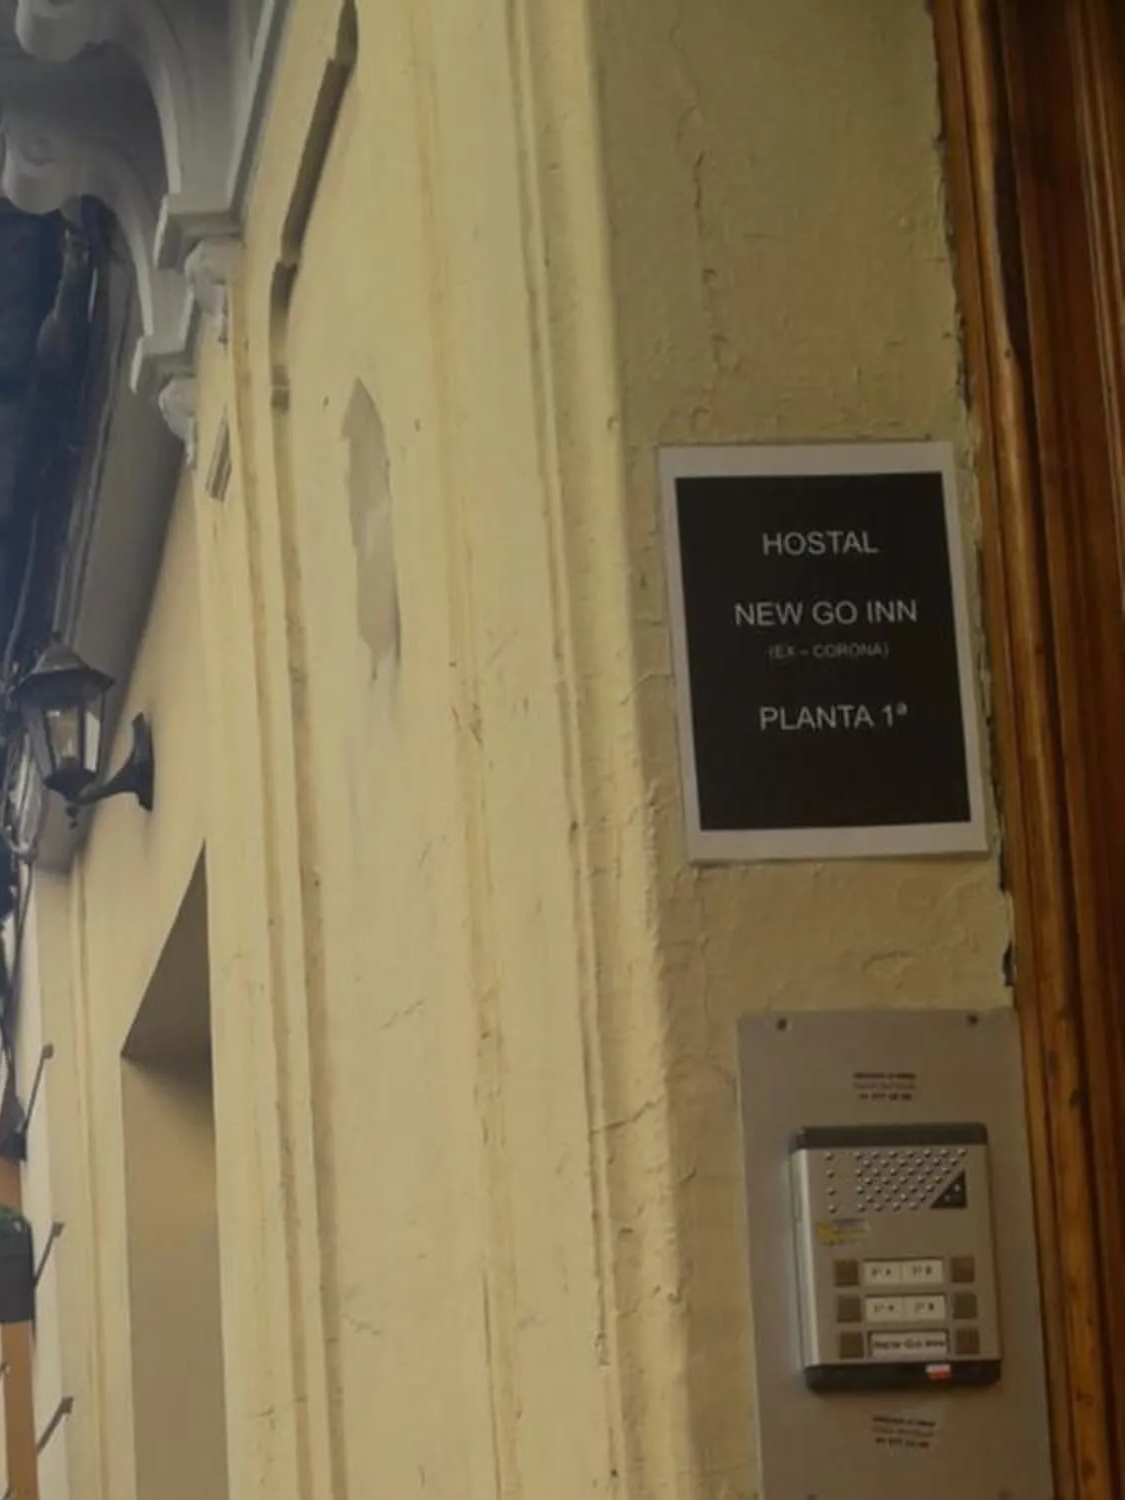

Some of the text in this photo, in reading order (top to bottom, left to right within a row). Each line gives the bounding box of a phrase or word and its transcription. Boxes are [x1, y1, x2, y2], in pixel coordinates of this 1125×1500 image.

[762, 529, 880, 556] HOSTAL
[734, 598, 918, 626] NEW GO INN
[812, 641, 890, 660] CORONA)
[759, 704, 875, 731] PLANTA
